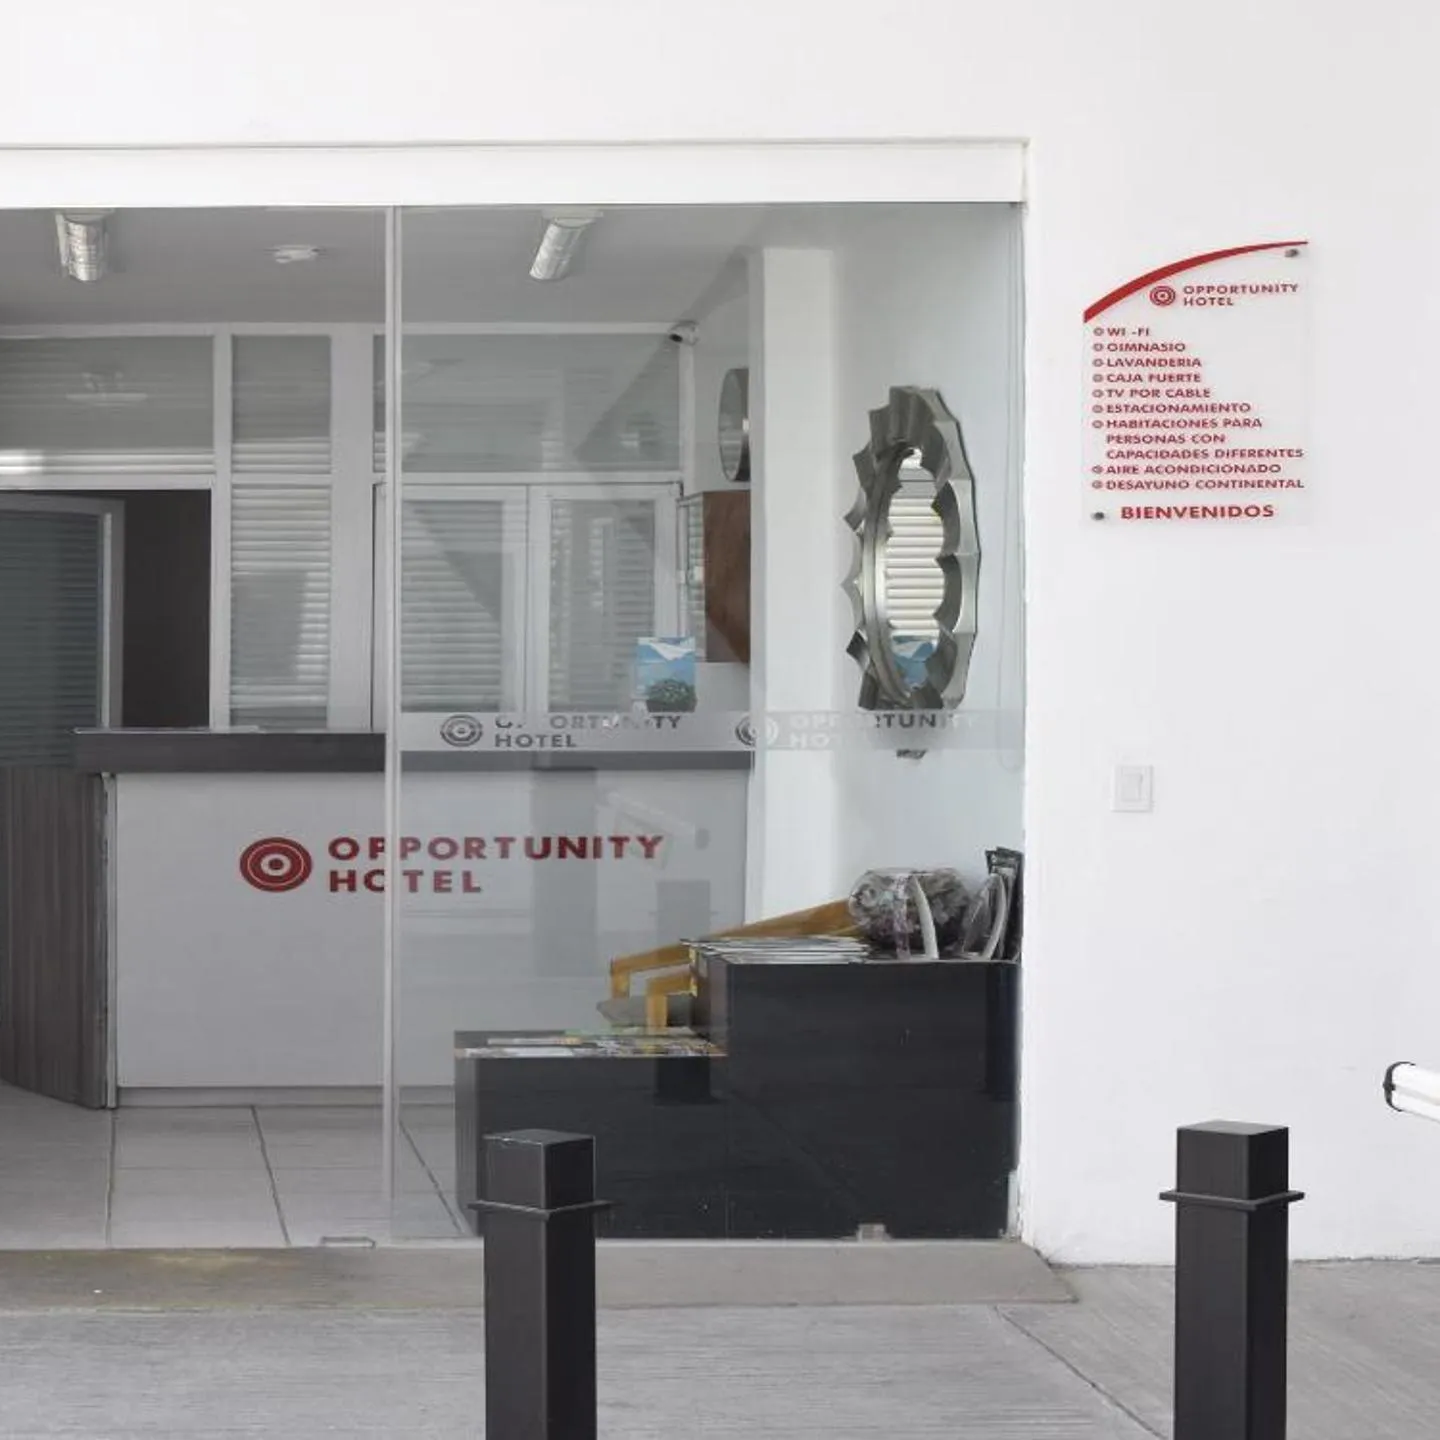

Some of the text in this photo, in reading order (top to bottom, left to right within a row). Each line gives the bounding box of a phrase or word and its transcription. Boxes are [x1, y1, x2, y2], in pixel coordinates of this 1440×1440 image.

[1183, 283, 1299, 295] OPPORTUNITY
[1183, 296, 1234, 307] HOTEL
[1107, 358, 1202, 368] LAVANDERIA
[1107, 373, 1202, 383] CAJA FUERTE
[1107, 388, 1211, 398] TV POR CABLE
[1107, 403, 1251, 414] ESTACIONAMIENTO
[1107, 418, 1262, 429] HABITACIONES PARA
[1107, 433, 1226, 444] PERSONAS CON
[1106, 448, 1304, 460] CAPACIDADES DIFERENTES
[1106, 463, 1281, 475] AIRE ACONDICIONADO
[1106, 478, 1304, 490] DESAYUNO CONTINENTAL
[1121, 504, 1274, 519] BIENVENIDOS
[495, 715, 681, 729] OORTNTY
[494, 734, 577, 748] HOTEL
[328, 836, 664, 861] OPPORTUNITY
[328, 870, 482, 893] HOTEL
